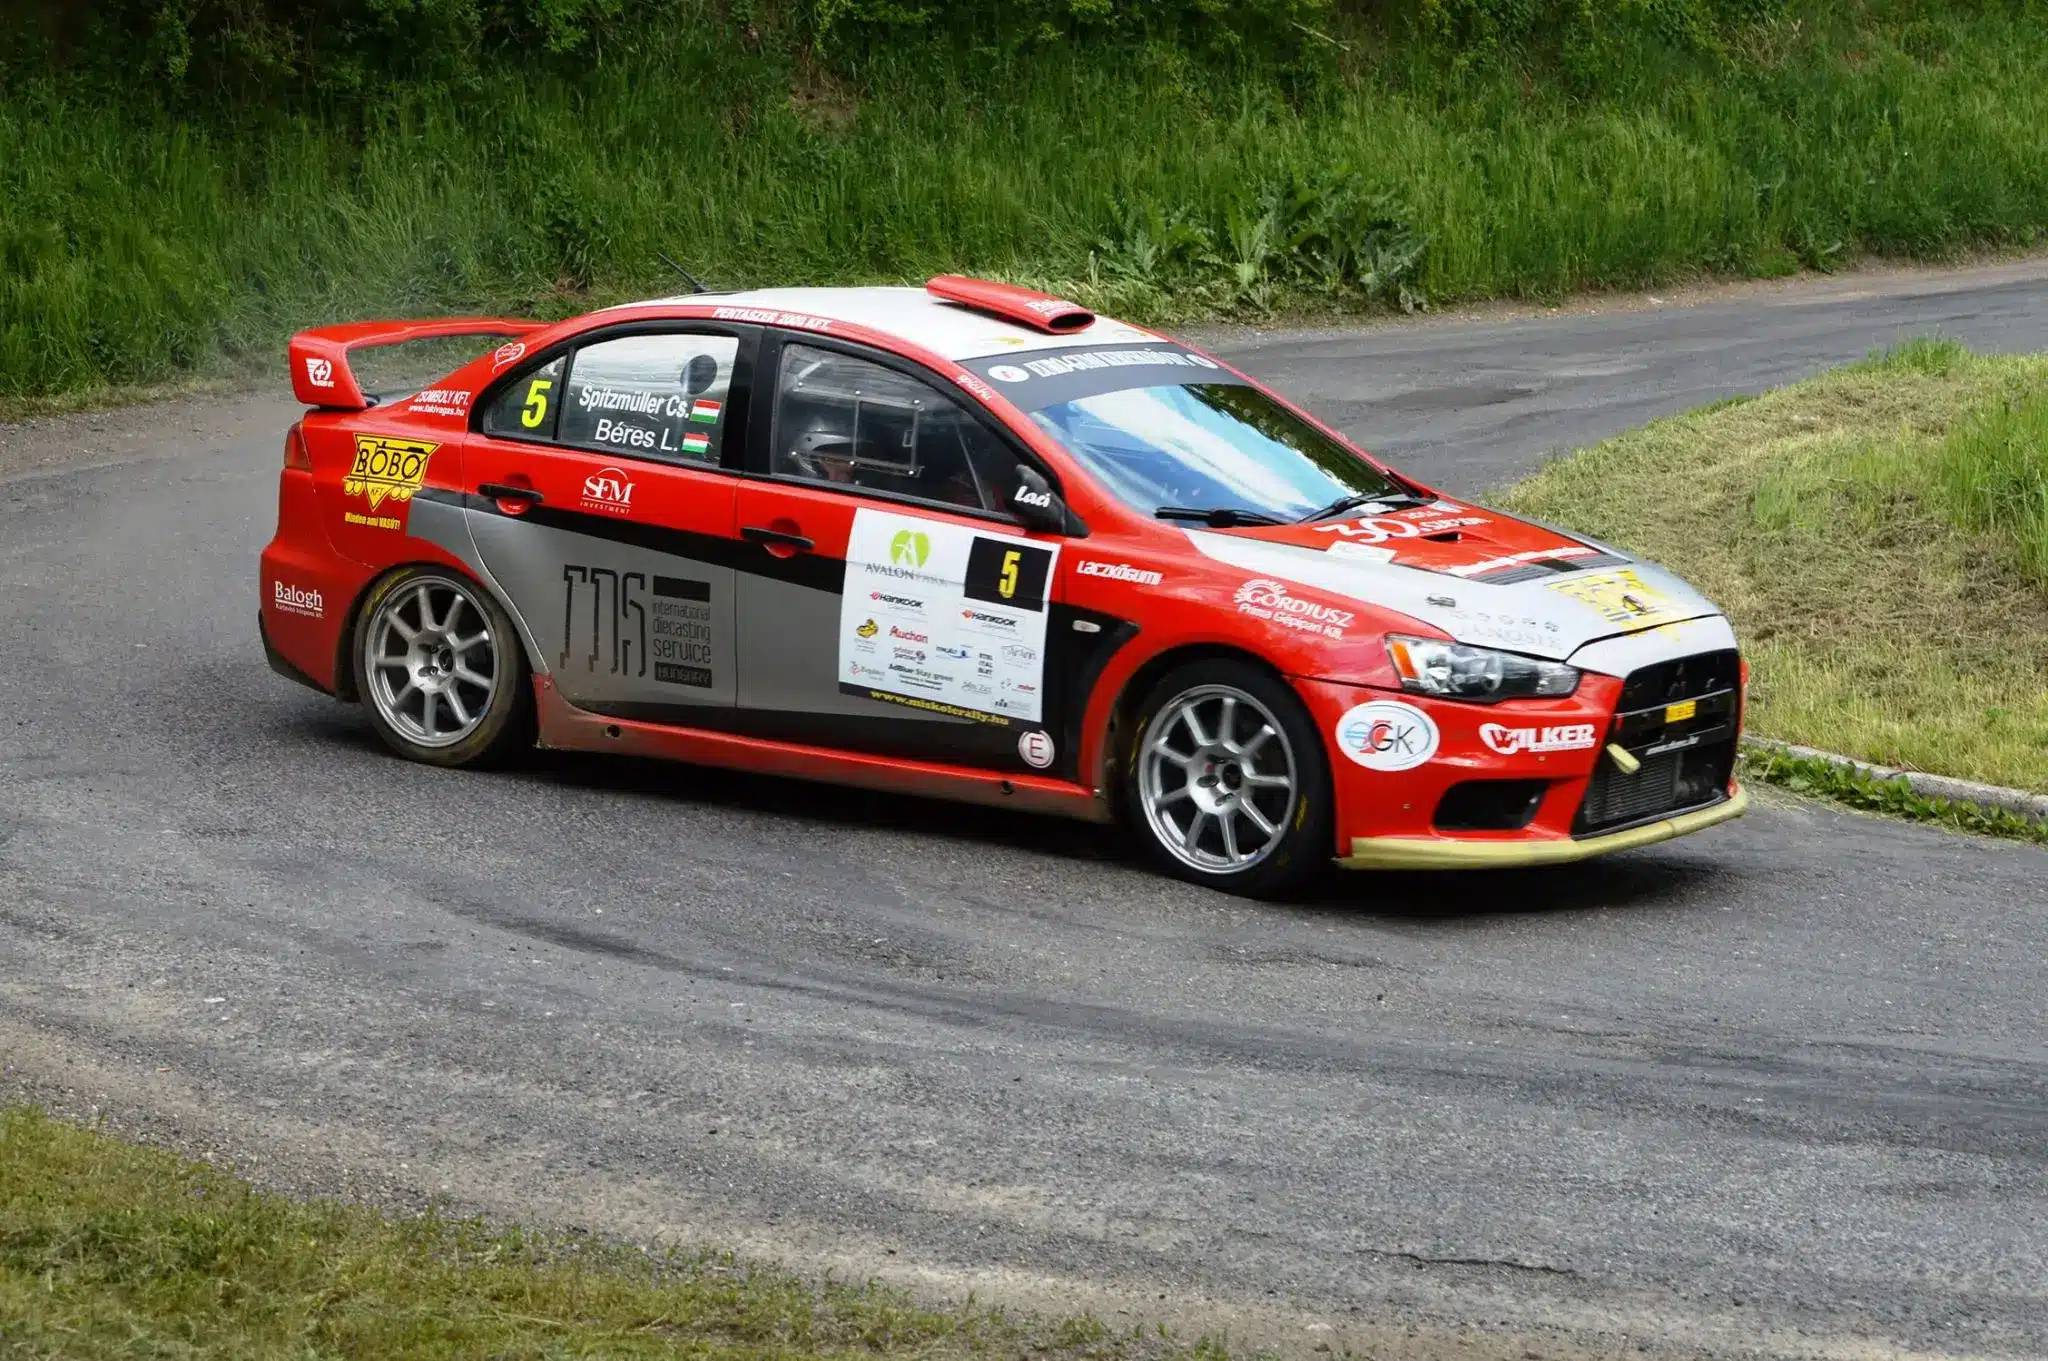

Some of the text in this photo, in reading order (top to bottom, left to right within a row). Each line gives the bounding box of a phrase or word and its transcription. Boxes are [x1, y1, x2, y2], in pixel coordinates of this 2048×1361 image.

[521, 379, 553, 429] 5
[579, 385, 690, 419] Spitzmüller Cs.
[595, 418, 679, 452] Béres L.
[355, 447, 421, 480] BOBO
[582, 475, 636, 505] SFM
[1014, 484, 1051, 508] Laci
[579, 501, 631, 514] INVESTMENT
[864, 562, 914, 581] AVALON
[998, 550, 1023, 599] 5
[274, 580, 323, 609] Balogh
[652, 600, 711, 622] international
[652, 617, 711, 645] diecasting
[888, 625, 929, 644] Auchan
[653, 637, 713, 665] service
[1029, 737, 1044, 760] E
